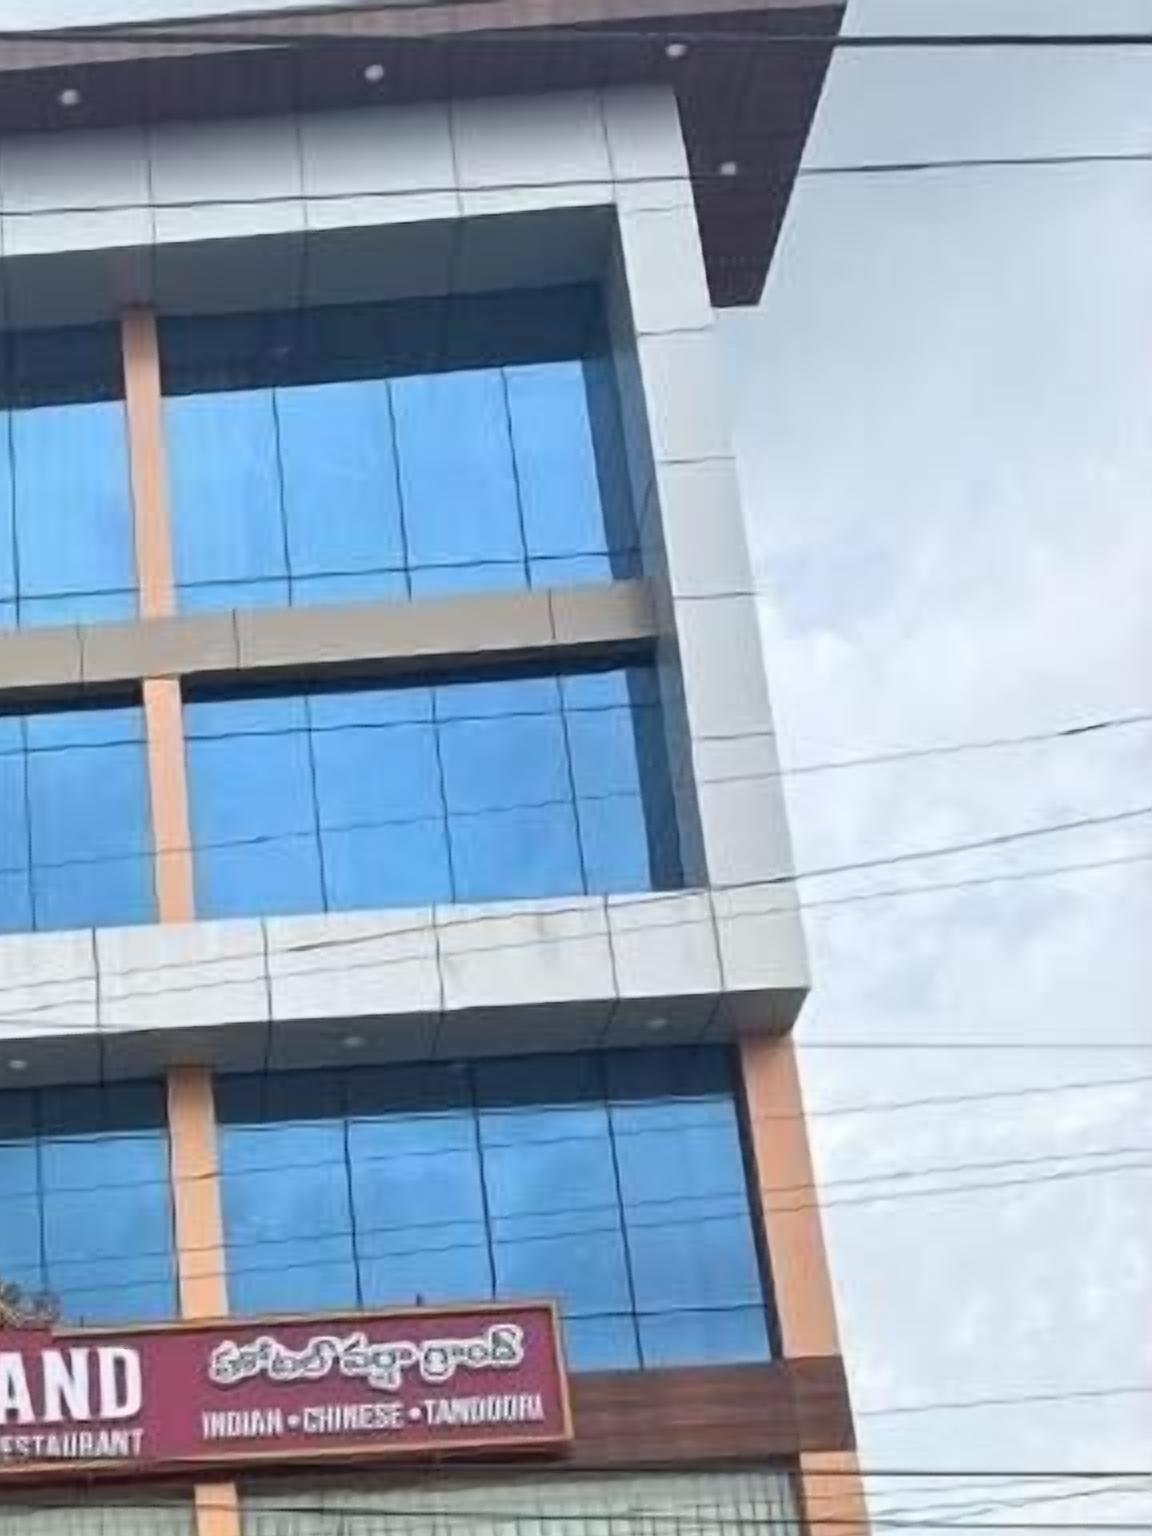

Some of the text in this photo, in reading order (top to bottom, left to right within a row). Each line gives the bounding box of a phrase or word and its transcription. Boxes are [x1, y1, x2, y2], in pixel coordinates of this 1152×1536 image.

[202, 1393, 545, 1440] INDIAN CHINESE TANDOORI
